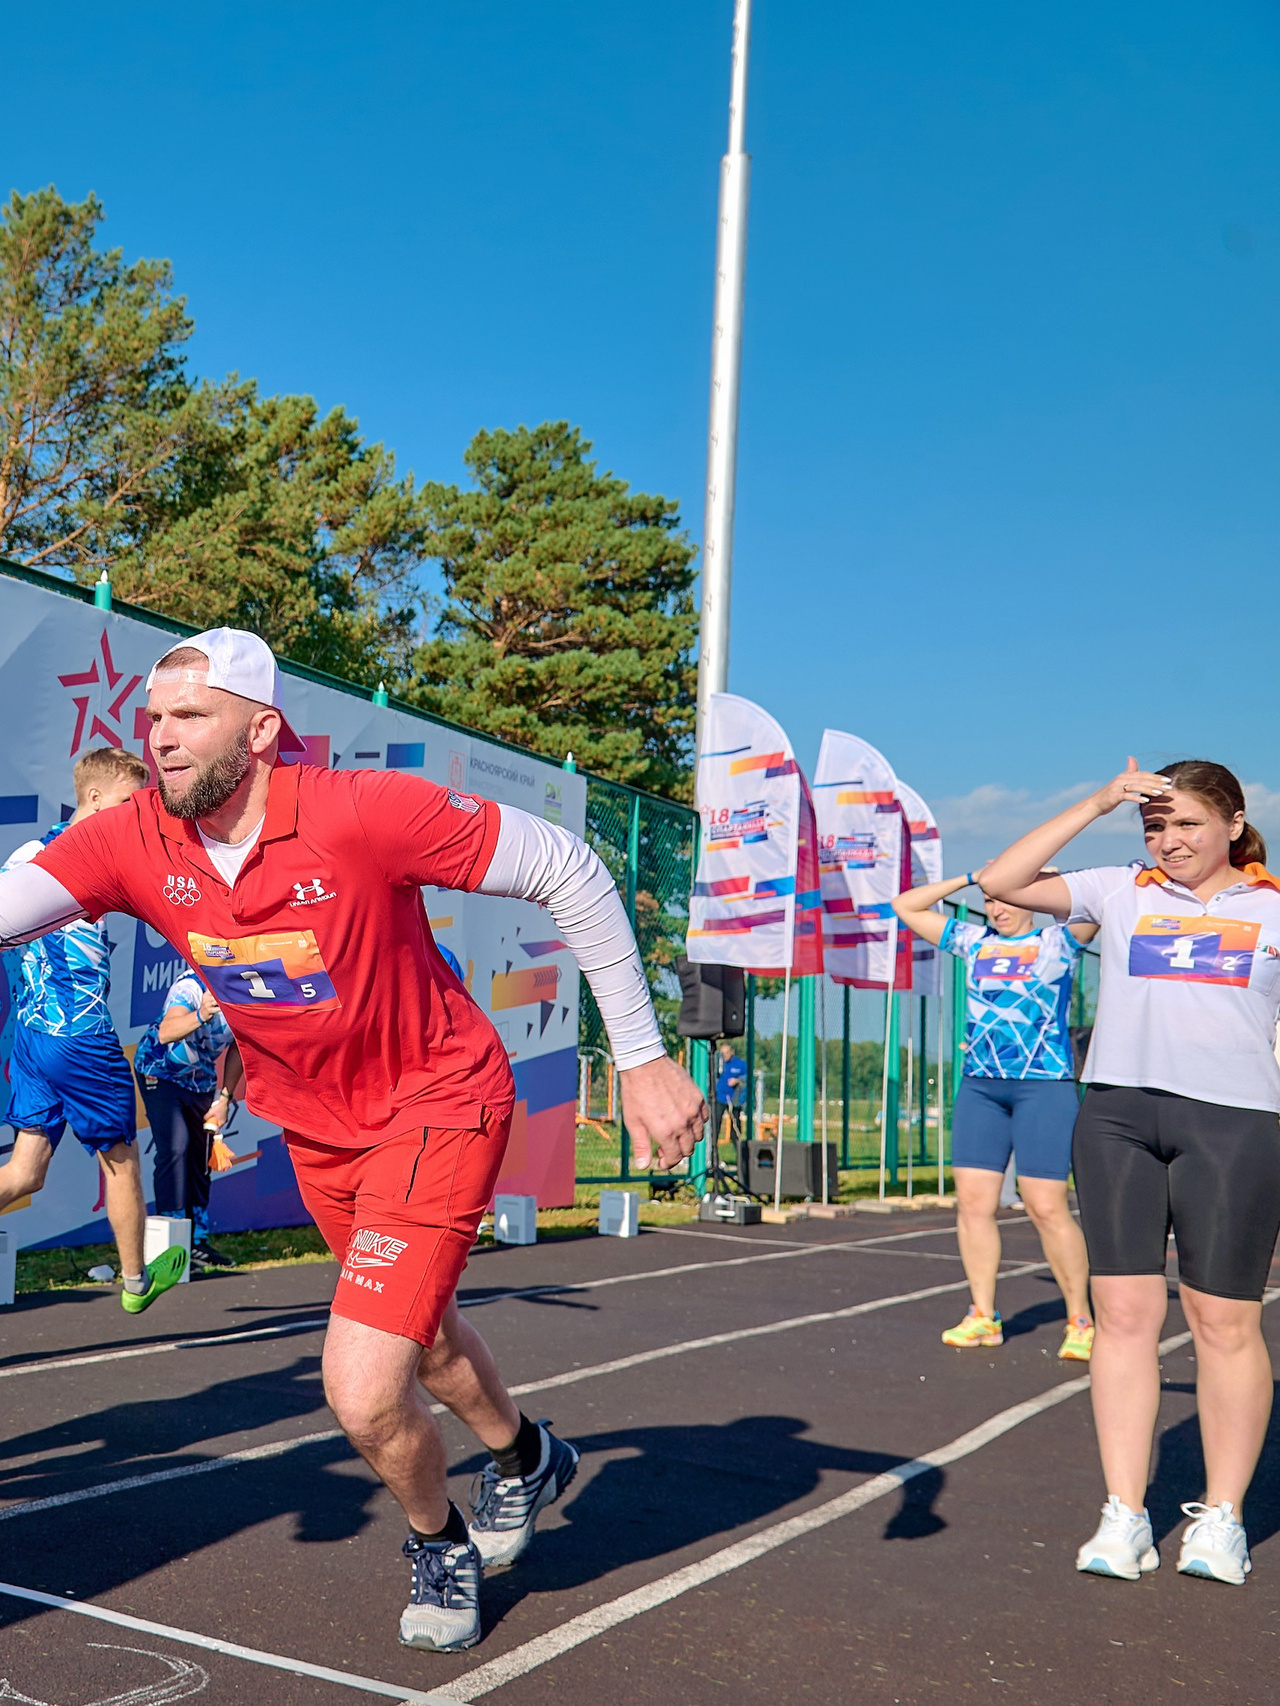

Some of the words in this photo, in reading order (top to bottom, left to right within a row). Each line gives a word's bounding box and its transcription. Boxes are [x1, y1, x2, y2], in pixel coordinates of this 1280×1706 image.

[709, 808, 729, 825] 18
[167, 874, 197, 889] USA
[991, 958, 1012, 974] 2
[1168, 939, 1195, 969] 1
[1221, 956, 1236, 971] 2
[142, 957, 189, 994] МИН
[239, 970, 276, 998] 1
[299, 982, 317, 998] 5
[351, 1228, 409, 1261] NIKE
[339, 1267, 354, 1282] AIR
[354, 1273, 385, 1294] MAX
